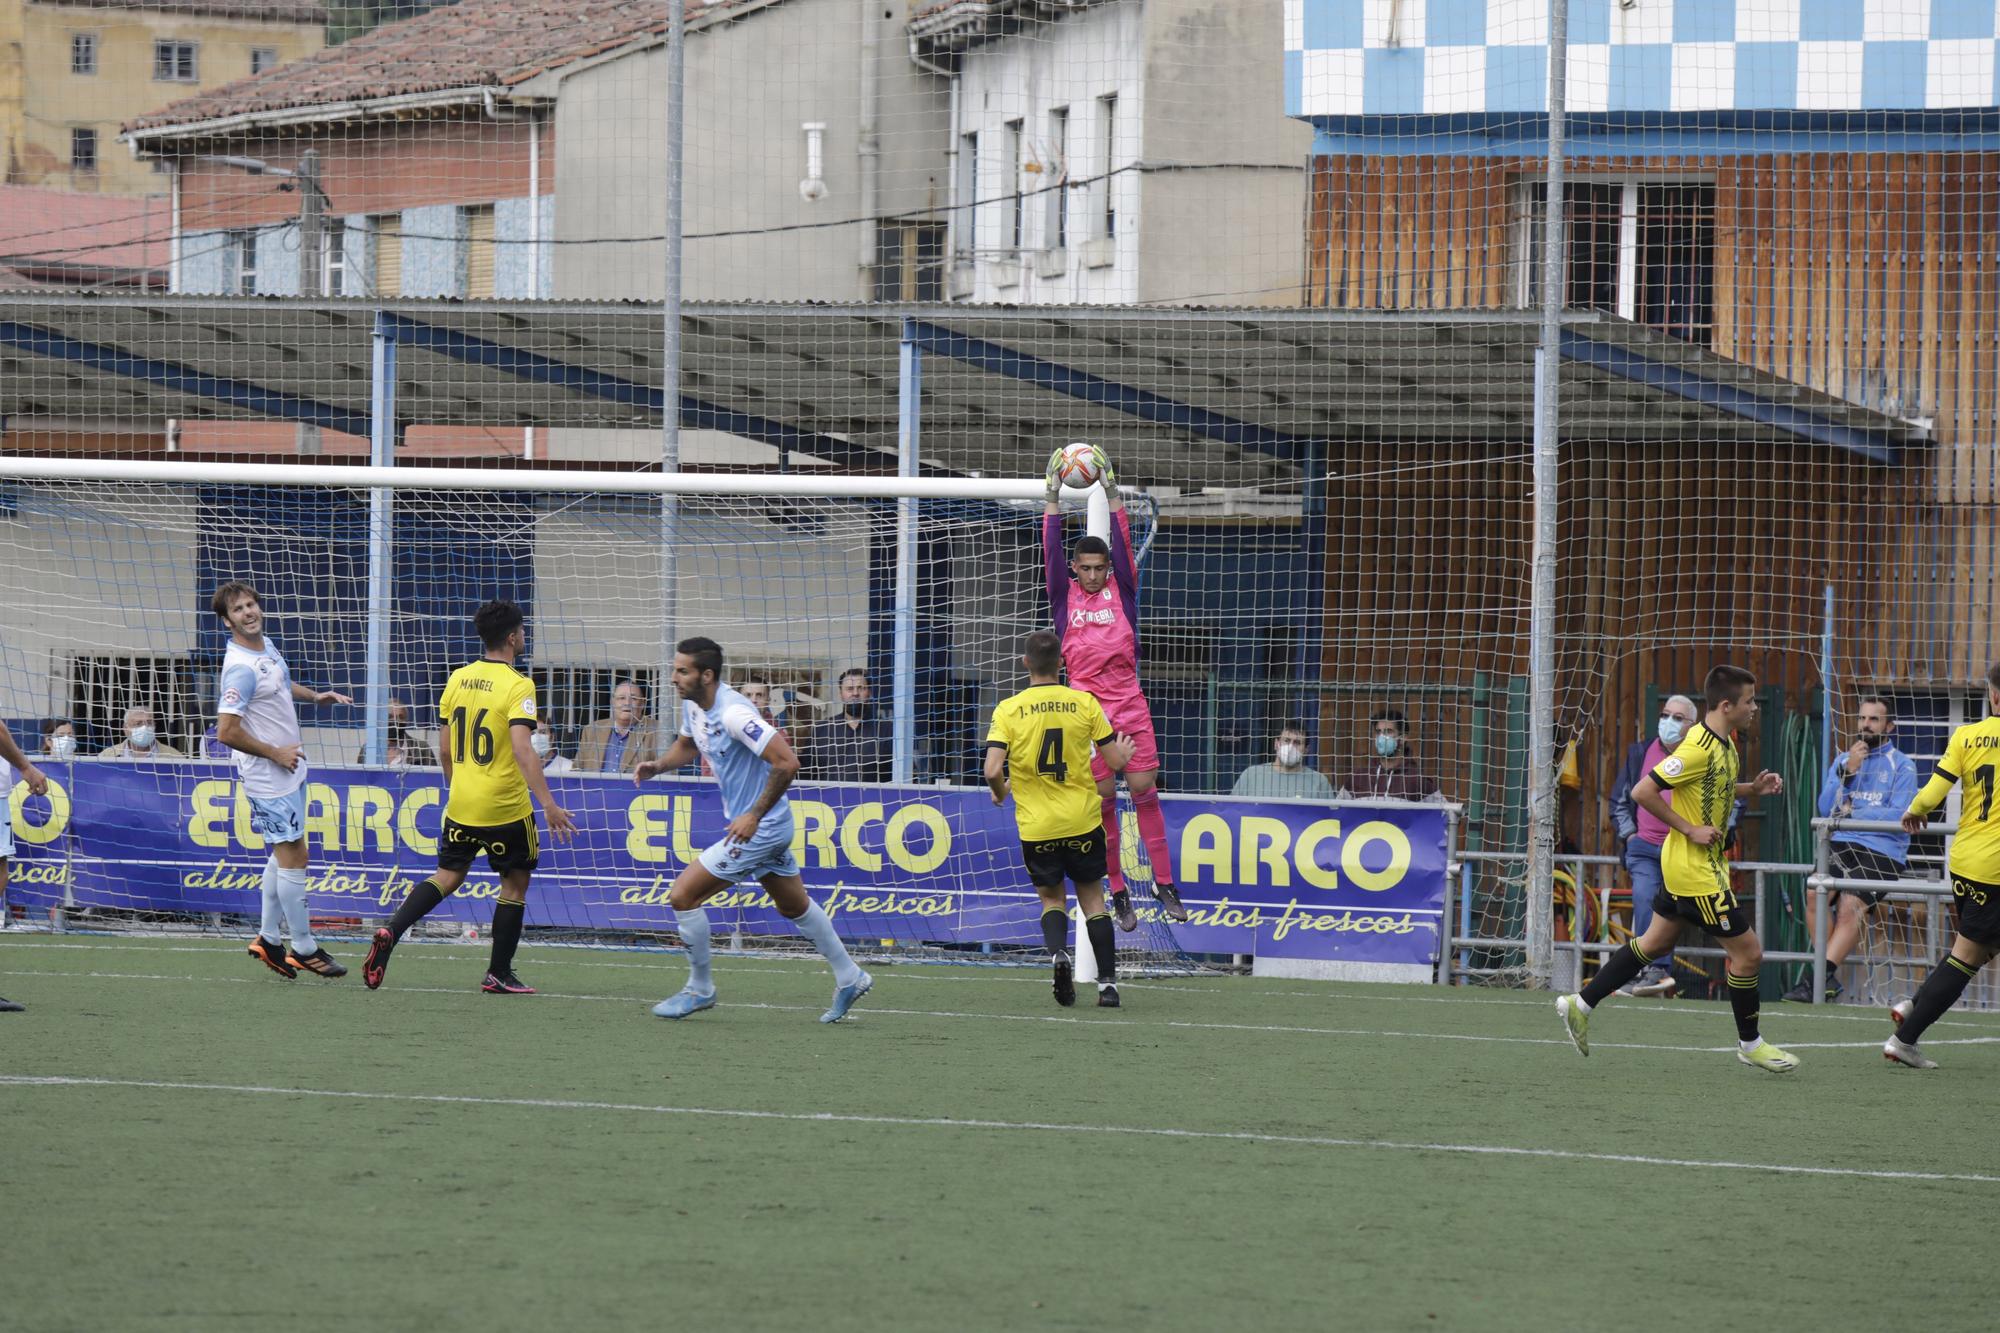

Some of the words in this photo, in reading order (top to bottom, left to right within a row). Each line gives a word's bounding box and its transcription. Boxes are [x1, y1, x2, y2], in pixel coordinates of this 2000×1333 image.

[460, 679, 493, 692] MANGEL
[1019, 706, 1028, 719] J.
[1031, 702, 1077, 714] MORENO
[452, 706, 494, 766] 16
[1036, 728, 1068, 784] 4
[1975, 735, 2000, 748] CON
[290, 811, 299, 832] 4
[305, 782, 488, 858] ARC
[788, 799, 952, 874] RCO
[1180, 813, 1412, 892] ARCO
[1273, 897, 1415, 941] frescos
